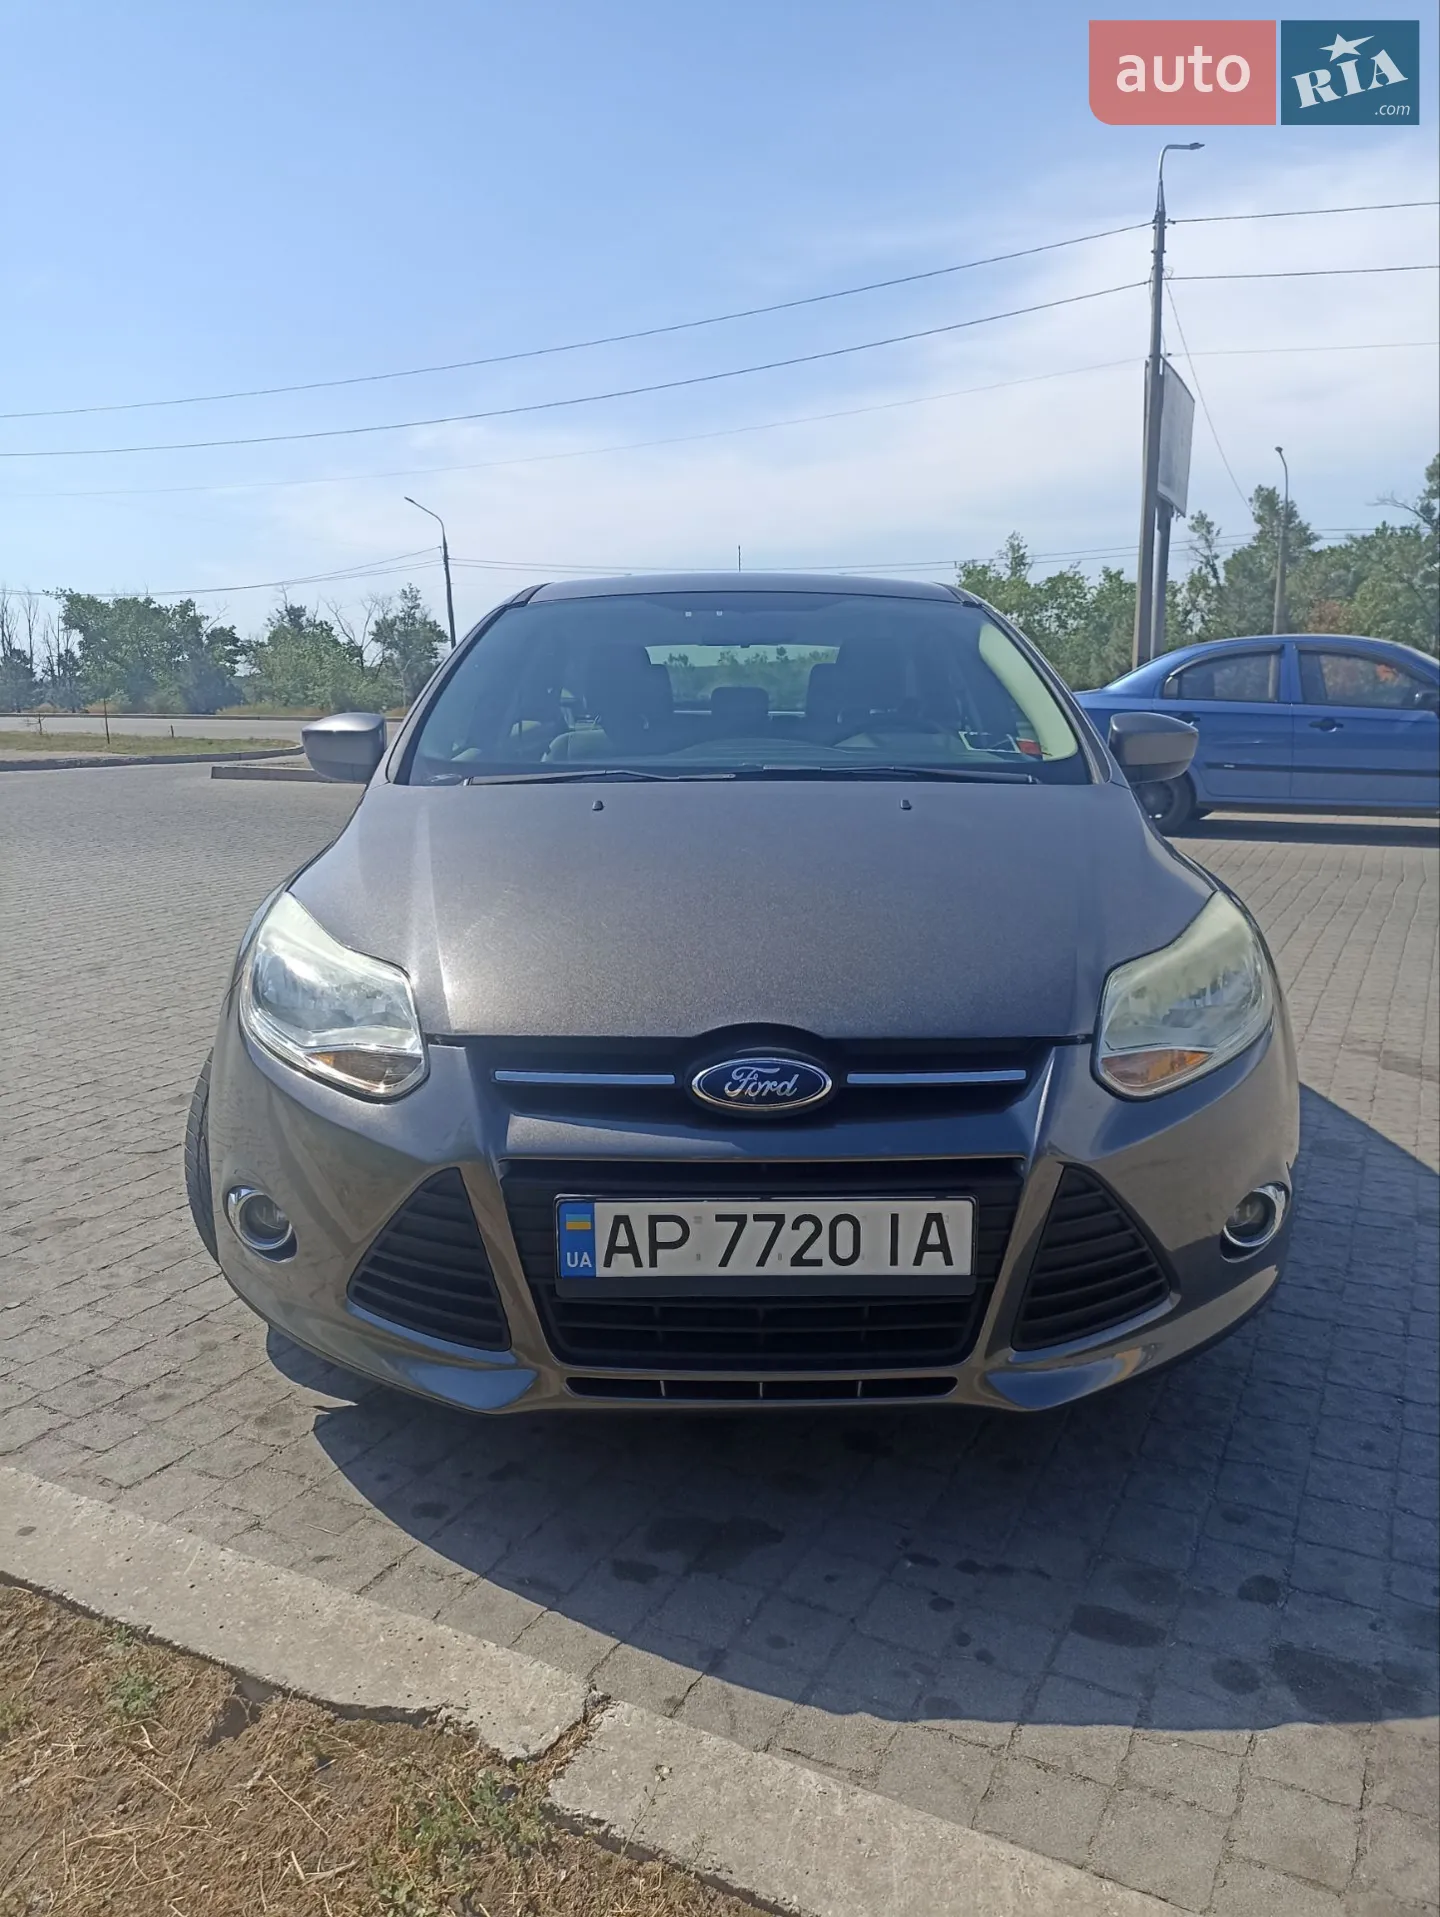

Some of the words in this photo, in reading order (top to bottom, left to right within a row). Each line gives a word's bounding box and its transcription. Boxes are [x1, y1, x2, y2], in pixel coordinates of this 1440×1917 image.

[724, 1066, 800, 1097] Ford
[603, 1214, 690, 1268] AP
[714, 1213, 861, 1267] 7720
[889, 1212, 954, 1267] IA
[566, 1252, 593, 1268] UA
